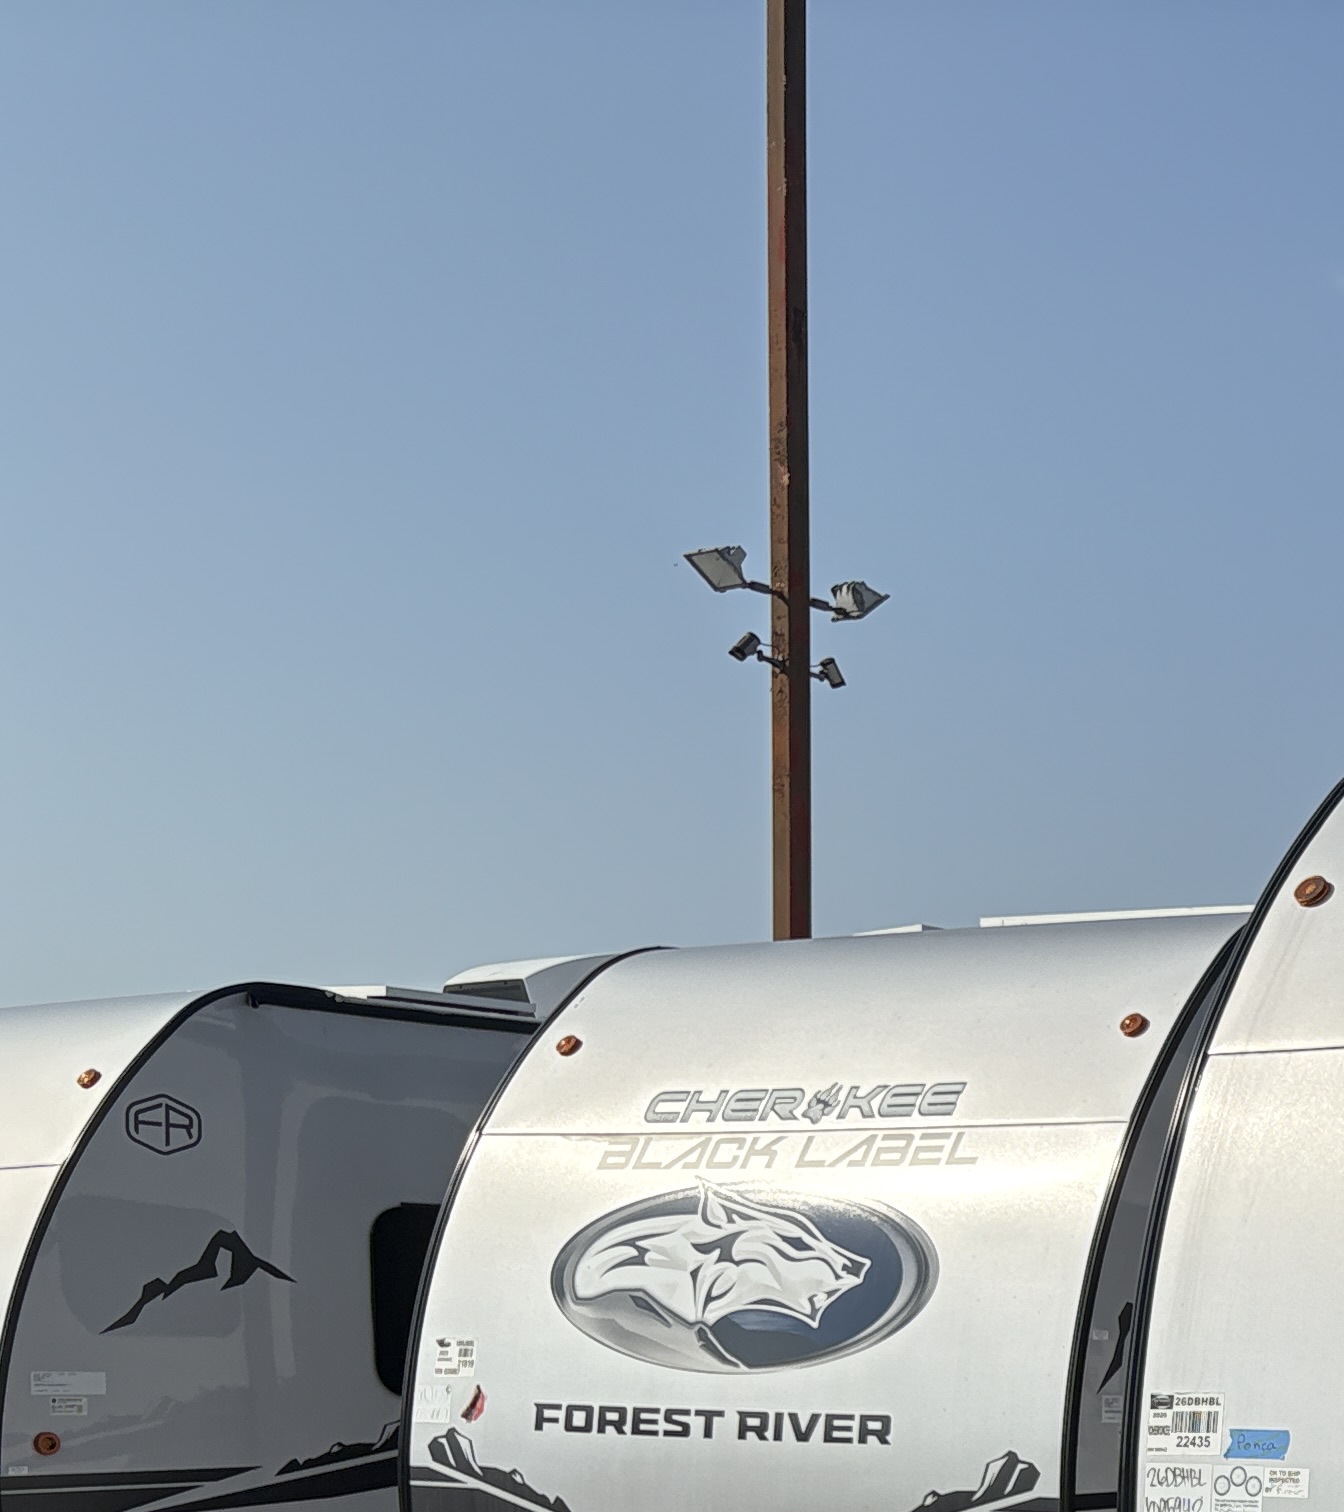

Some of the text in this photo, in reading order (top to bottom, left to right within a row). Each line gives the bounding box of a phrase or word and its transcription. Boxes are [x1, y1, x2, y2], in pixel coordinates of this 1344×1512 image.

[597, 1130, 980, 1171] BLACK LABEL
[533, 1402, 893, 1446] FOREST RIVER
[1175, 1435, 1211, 1448] 22435
